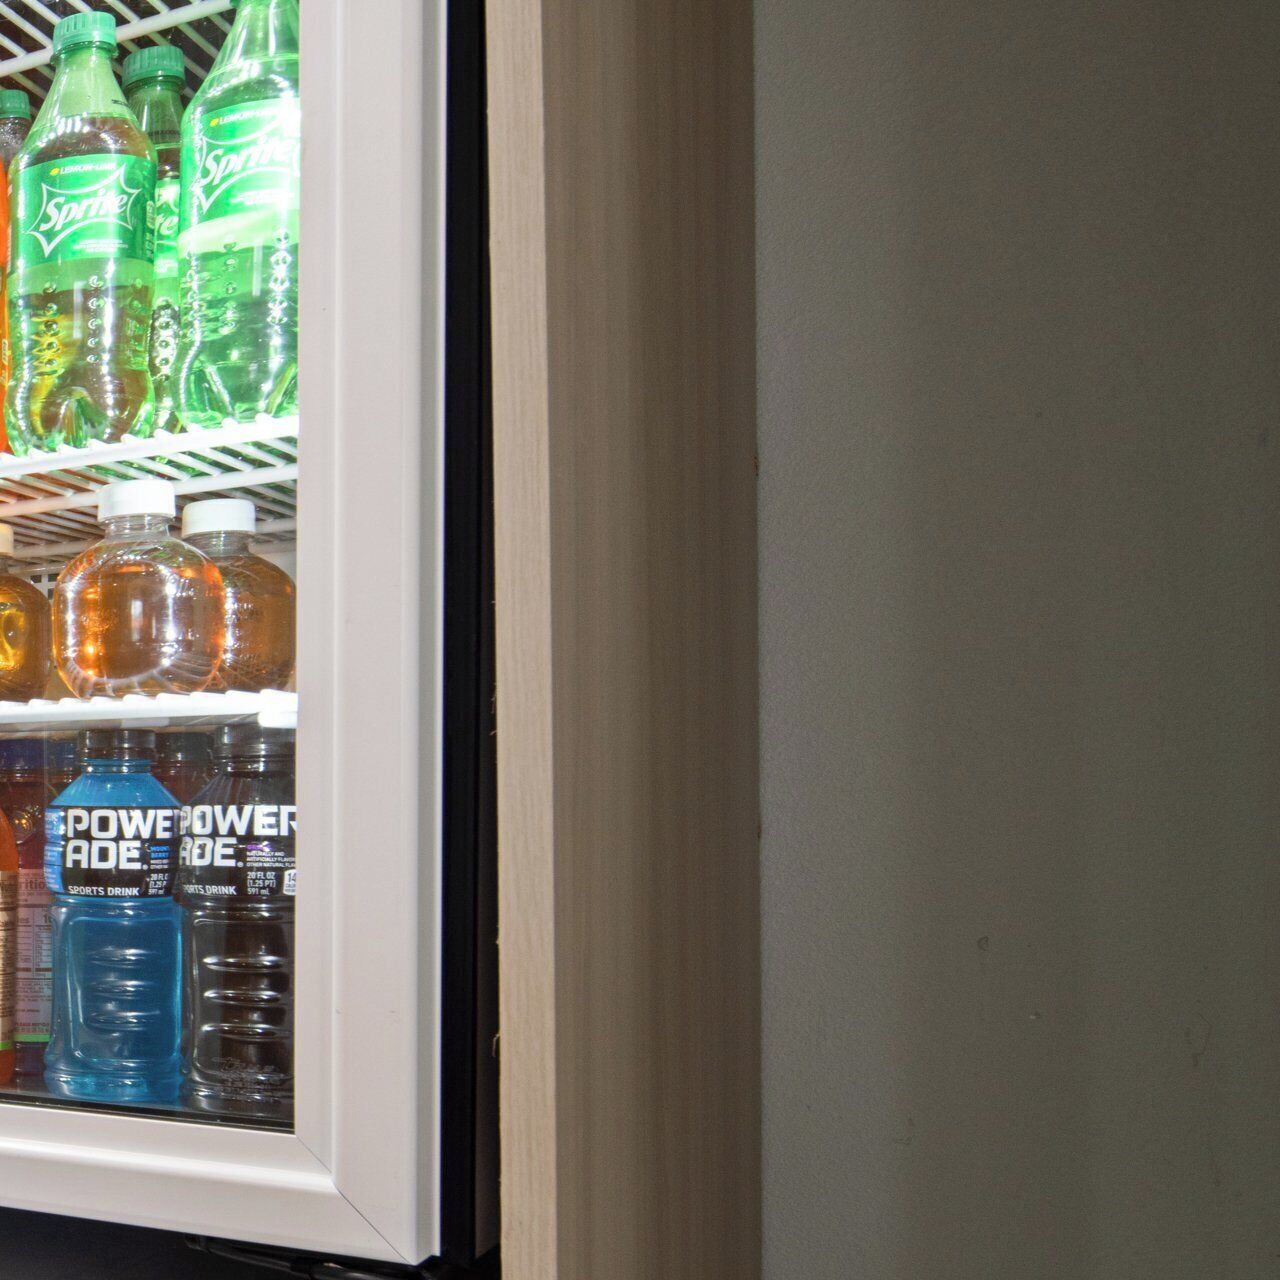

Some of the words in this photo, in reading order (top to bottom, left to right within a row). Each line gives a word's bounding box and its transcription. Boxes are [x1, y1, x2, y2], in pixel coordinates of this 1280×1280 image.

[200, 137, 292, 186] Sprite
[38, 188, 128, 232] Sprite
[66, 839, 142, 870] ADE
[179, 836, 238, 866] ADE
[68, 886, 104, 896] SPORTS
[107, 887, 140, 896] DRINK
[206, 886, 237, 895] DRINK
